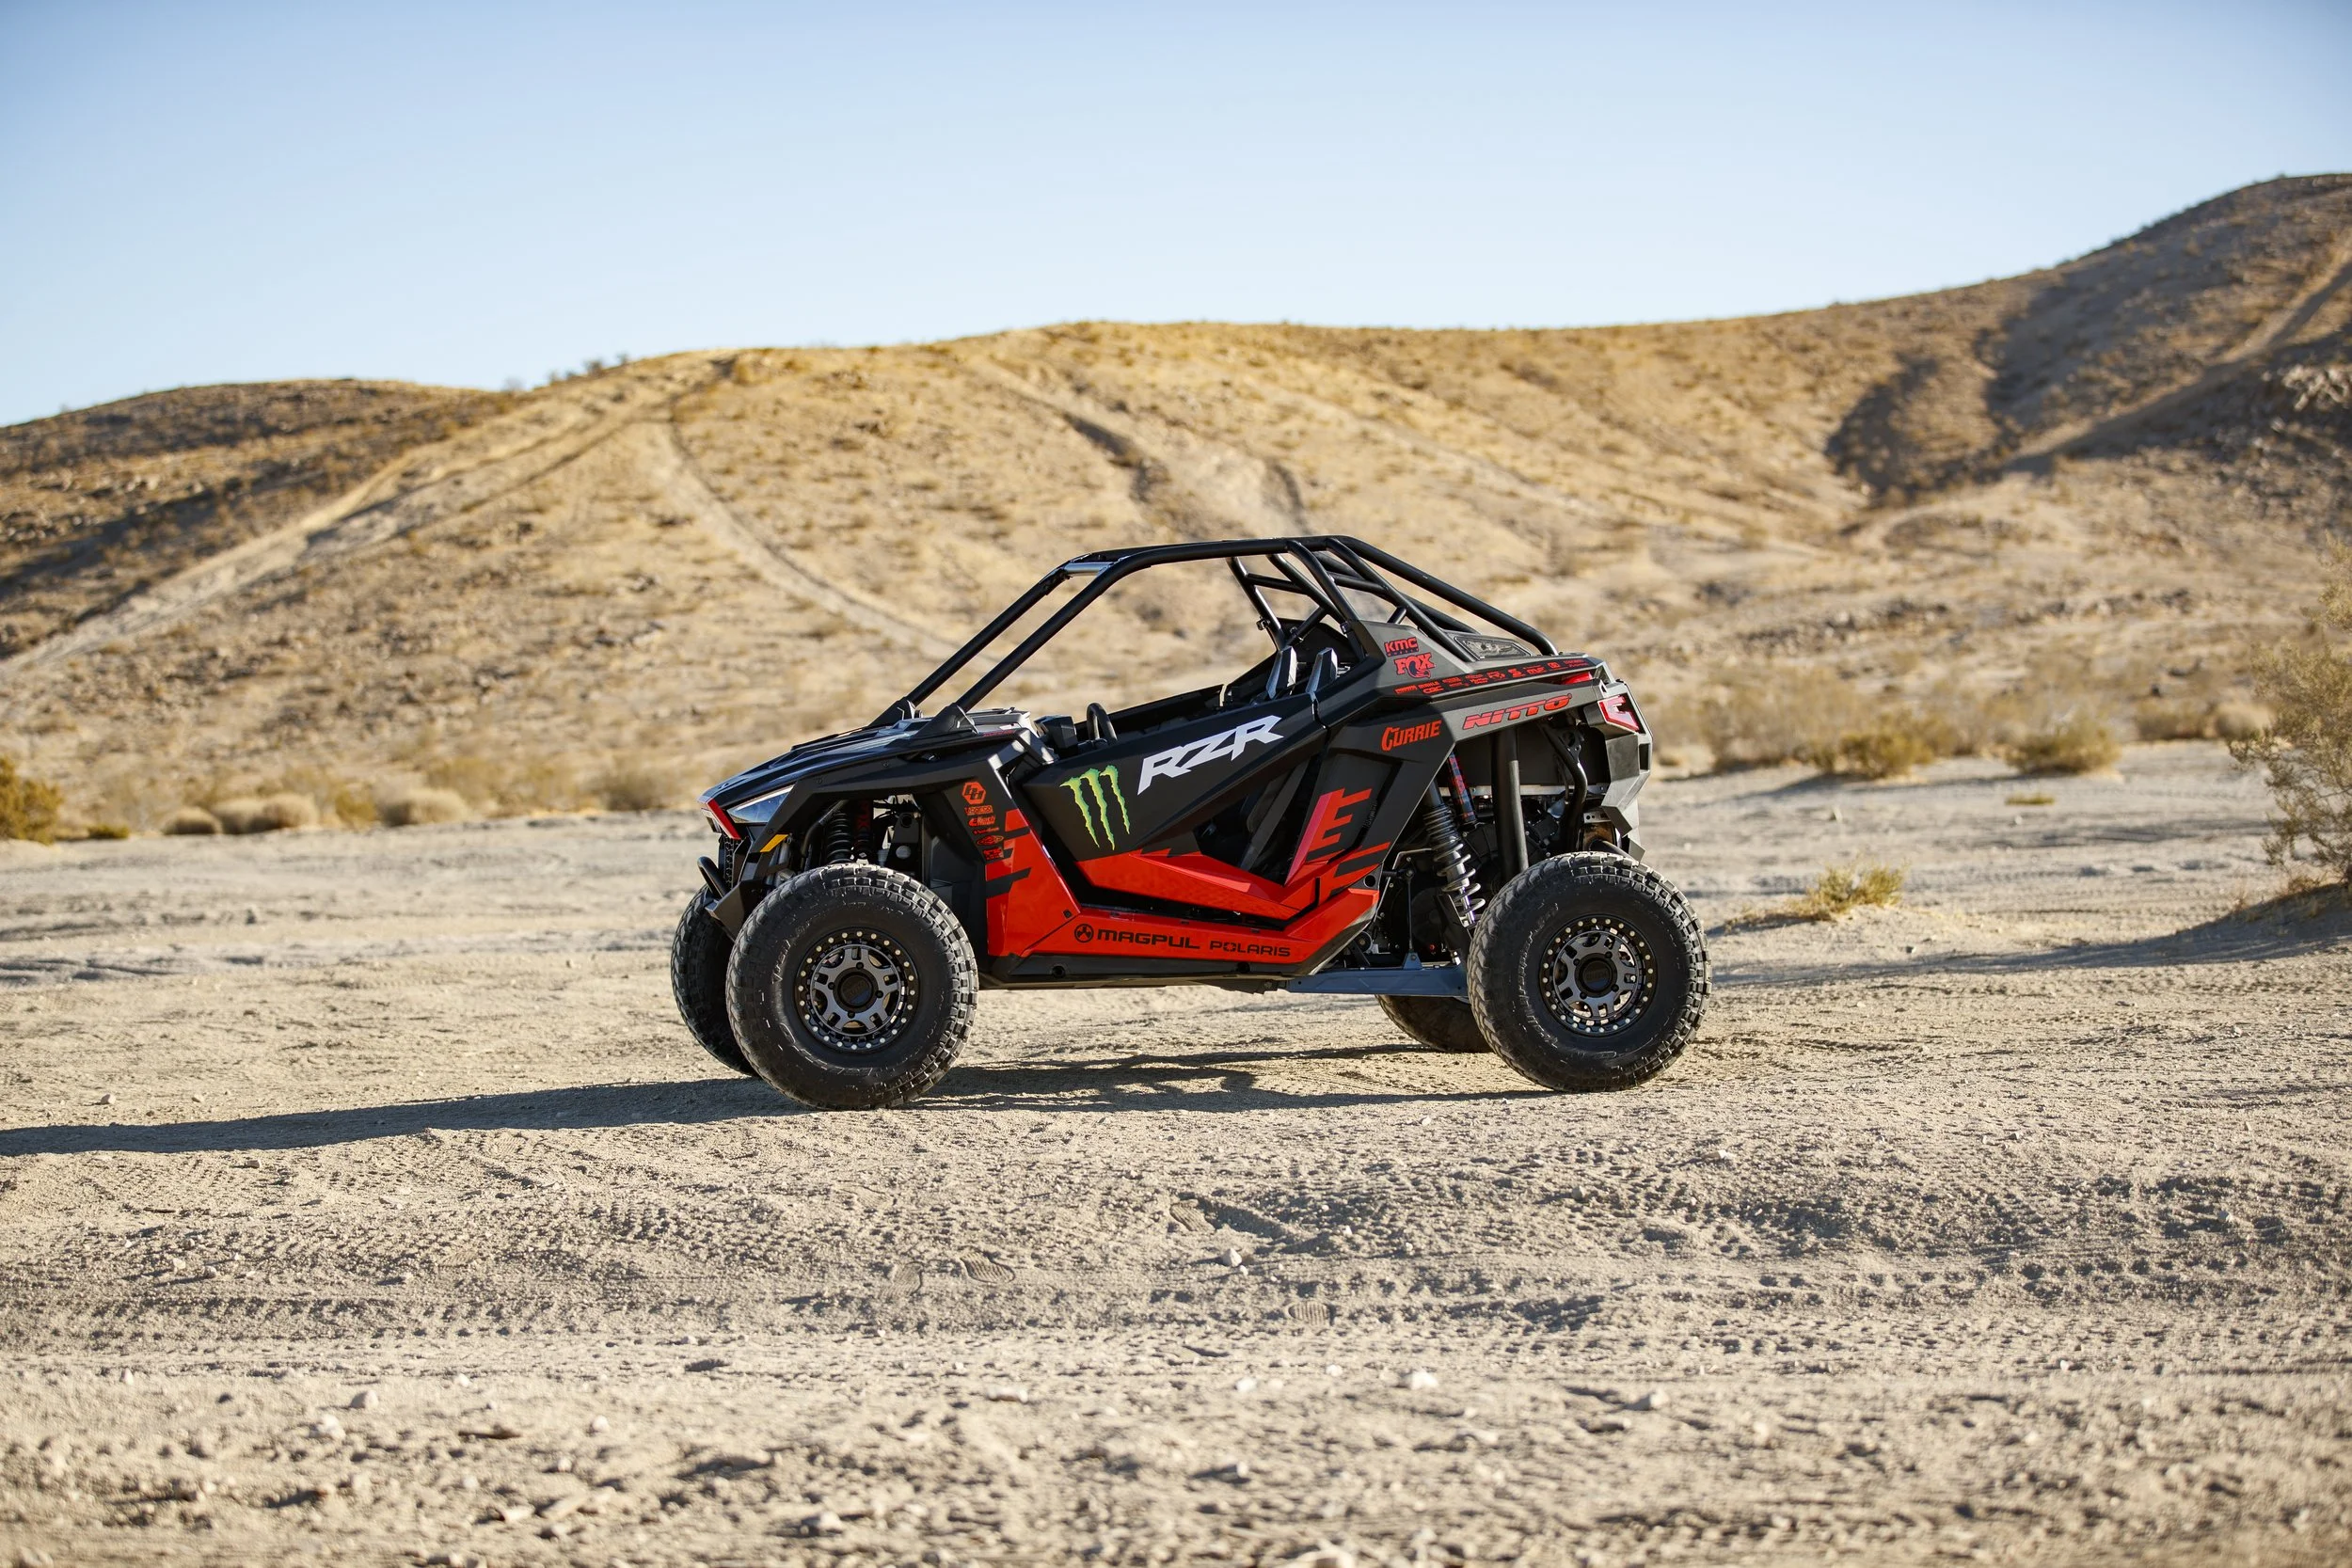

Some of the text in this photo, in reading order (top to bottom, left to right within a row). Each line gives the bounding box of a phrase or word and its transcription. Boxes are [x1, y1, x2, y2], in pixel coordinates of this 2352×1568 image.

[1384, 637, 1418, 653] KMC
[1394, 652, 1436, 677] FOX
[1462, 694, 1570, 730] NITTO
[1381, 720, 1442, 752] CURRIE
[1137, 715, 1284, 796] RZR
[1097, 928, 1200, 949] MAGPUL
[1209, 941, 1291, 957] POLARIS
